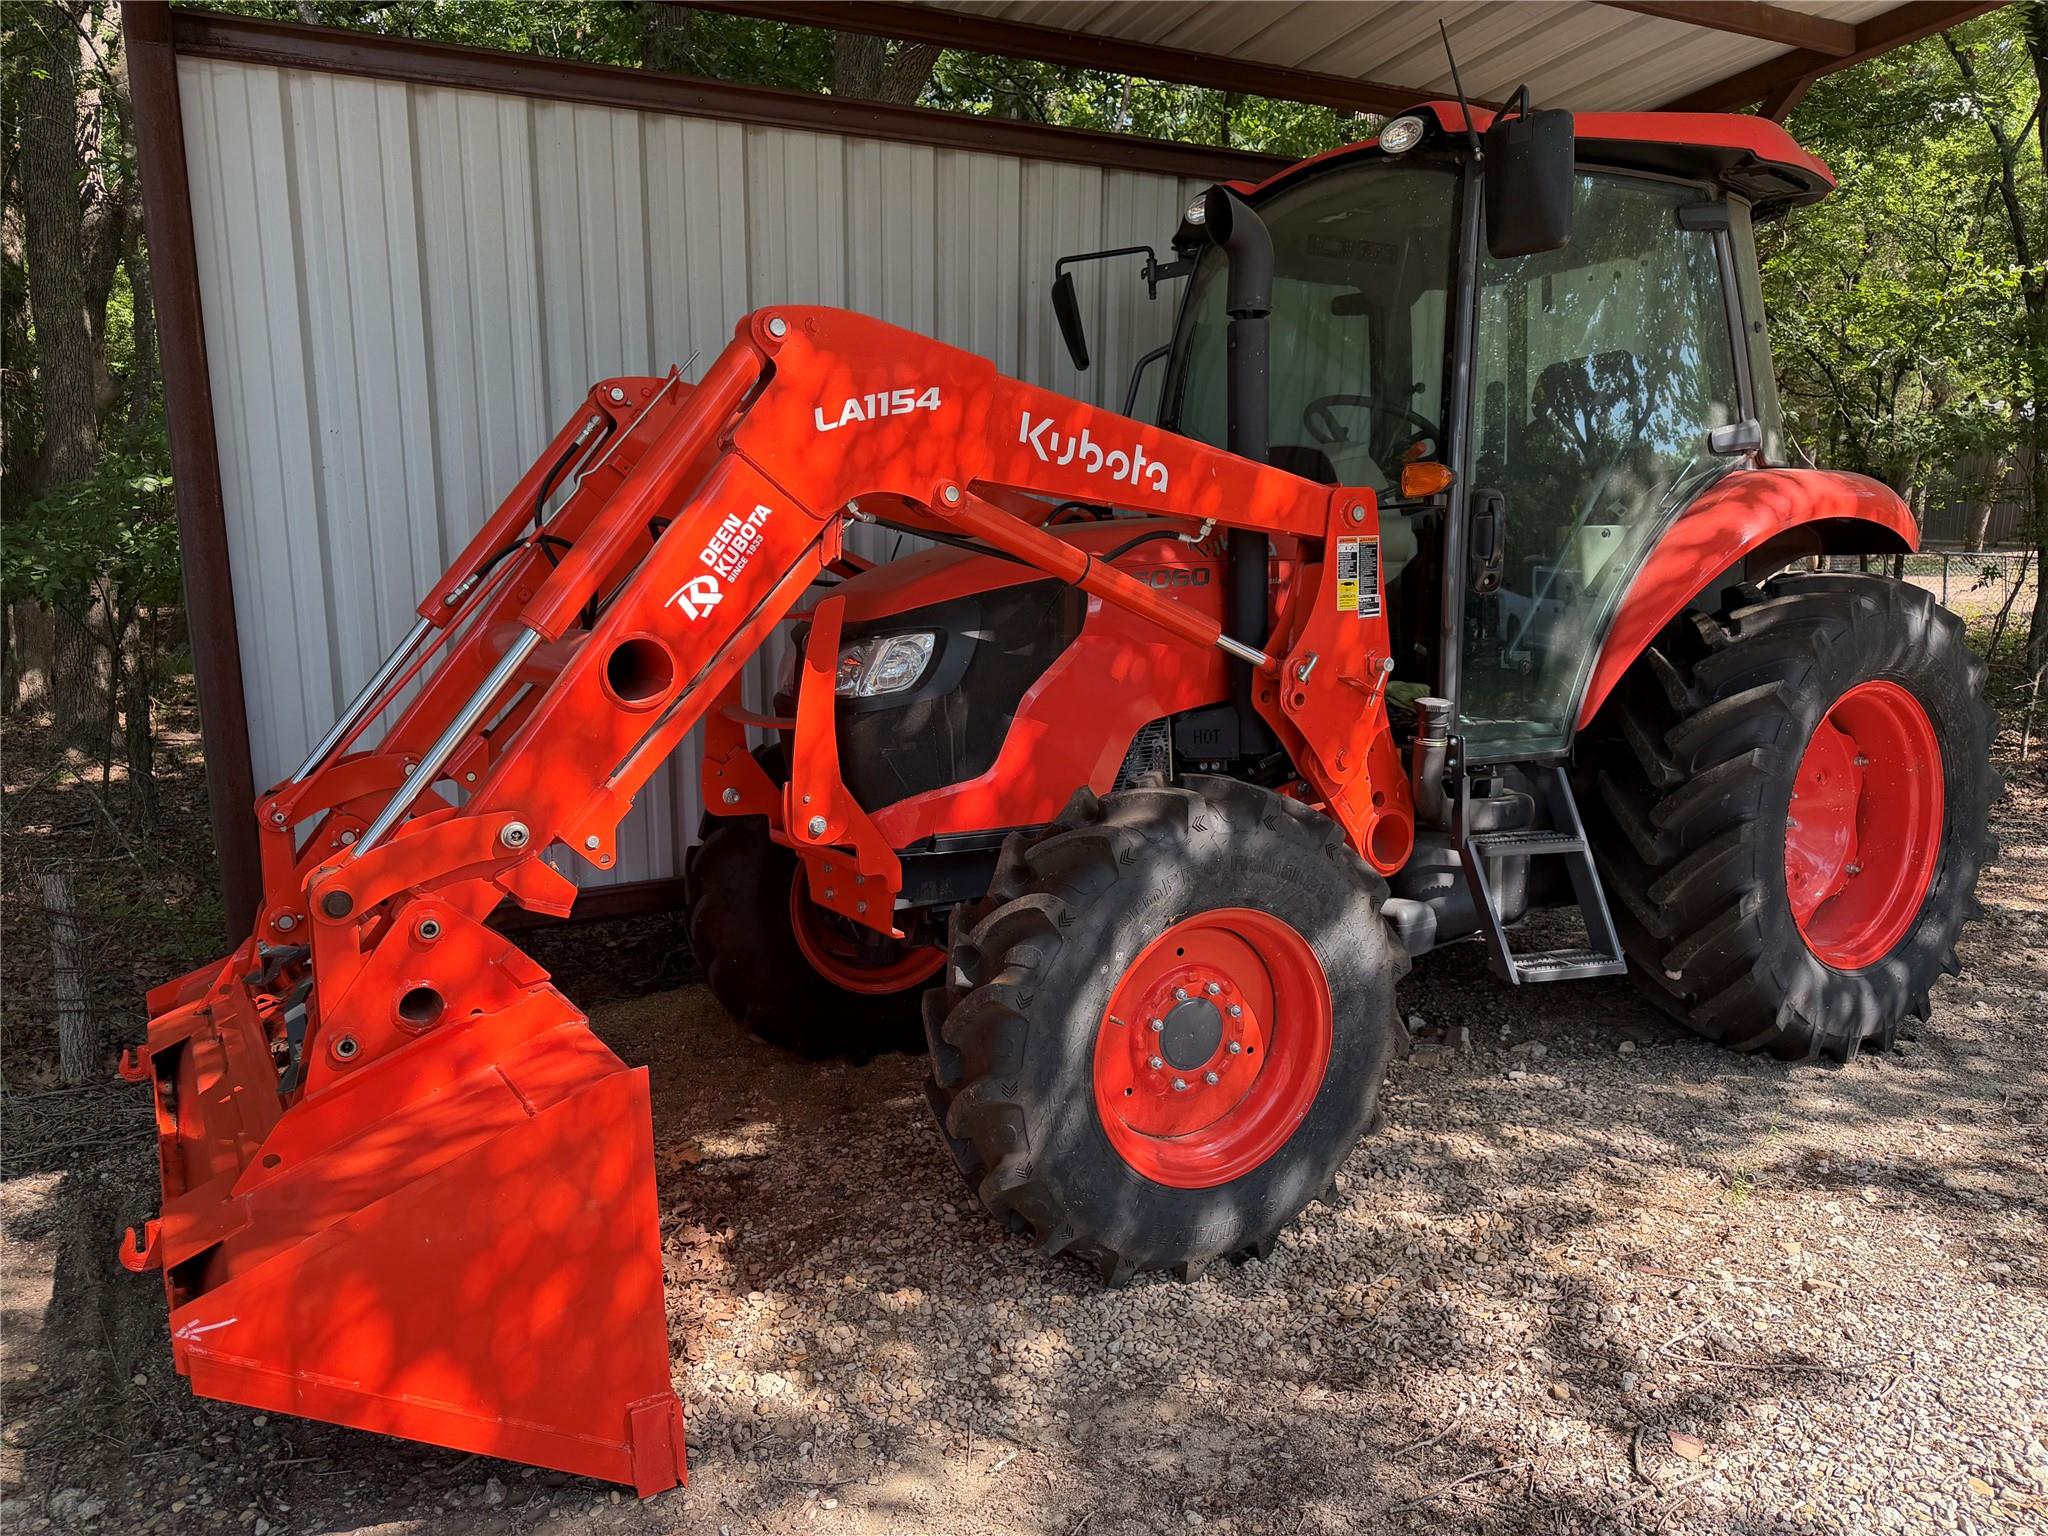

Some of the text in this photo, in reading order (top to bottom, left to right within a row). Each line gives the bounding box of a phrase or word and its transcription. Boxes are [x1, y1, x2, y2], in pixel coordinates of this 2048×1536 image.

[814, 386, 942, 432] LA1154
[1018, 410, 1170, 494] Kubota
[699, 512, 743, 567] DEEN
[713, 504, 772, 578] KUBOTA
[727, 534, 764, 583] SINCE 1933
[1193, 728, 1220, 745] HOT
